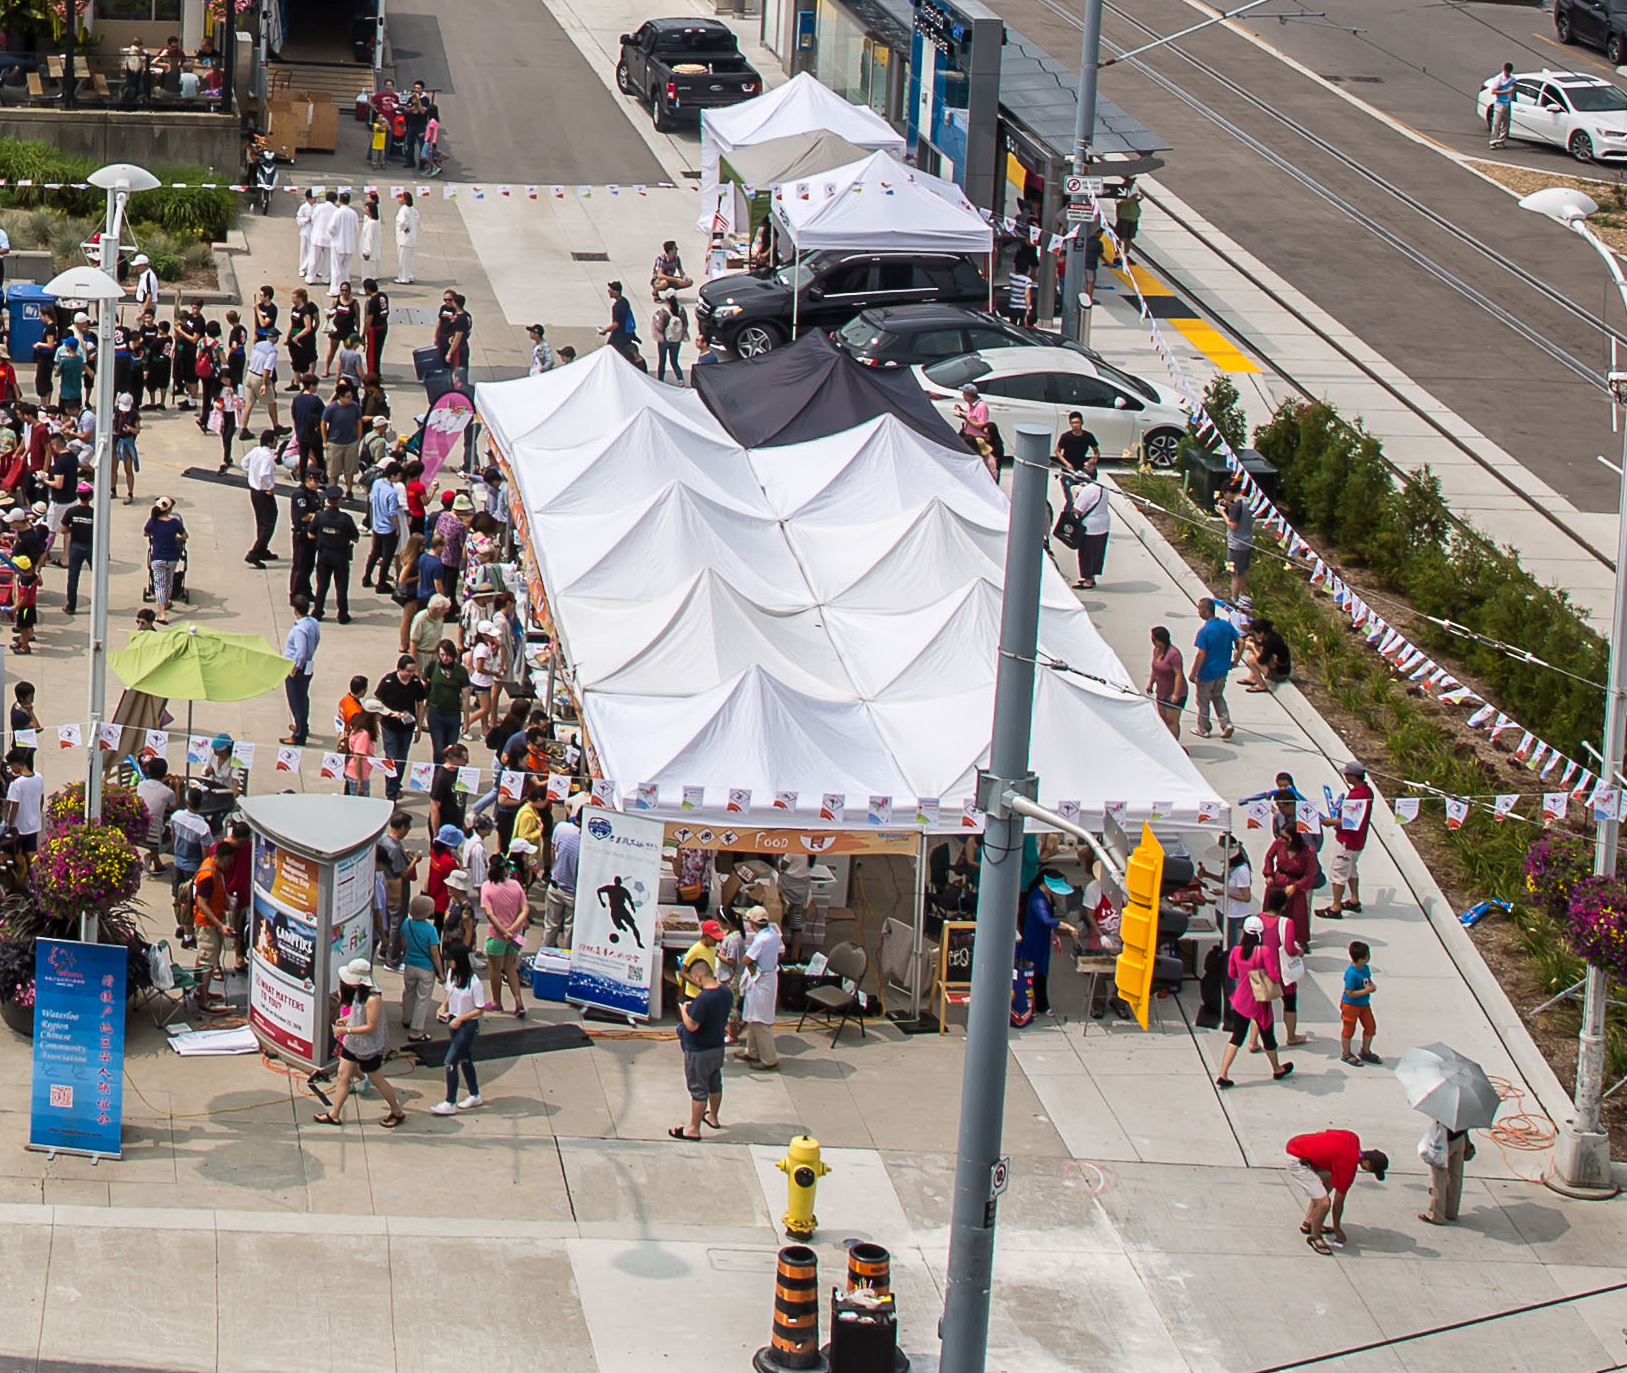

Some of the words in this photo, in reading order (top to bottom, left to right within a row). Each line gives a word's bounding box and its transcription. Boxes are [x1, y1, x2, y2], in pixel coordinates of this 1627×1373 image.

[260, 980, 275, 996] WHAT
[275, 989, 306, 1013] MATTERS
[41, 1009, 80, 1021] Waterloo
[40, 1019, 70, 1032] Region
[39, 1030, 72, 1041] Chinese
